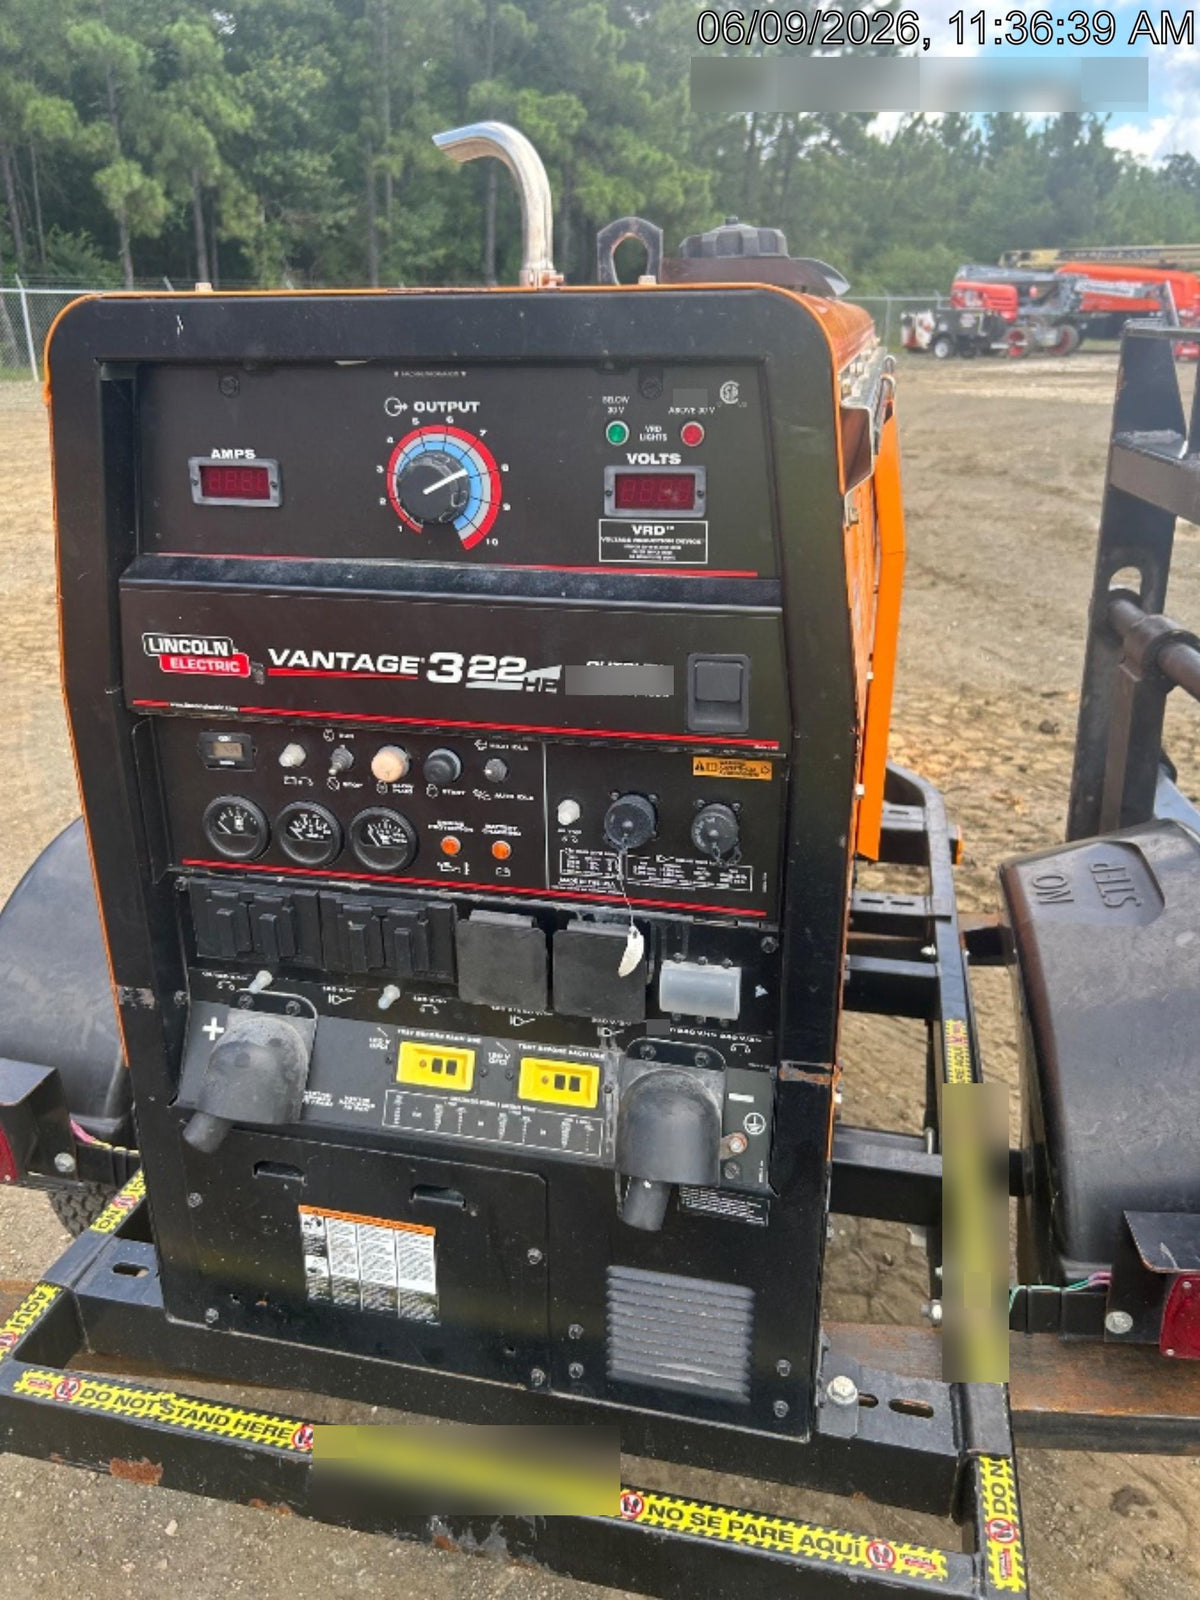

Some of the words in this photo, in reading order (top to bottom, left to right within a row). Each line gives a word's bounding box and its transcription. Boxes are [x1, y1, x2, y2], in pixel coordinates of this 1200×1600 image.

[413, 400, 481, 413] OUTPUT
[412, 417, 420, 426] 5
[445, 415, 454, 424] 6
[479, 429, 488, 437] 7
[639, 433, 668, 443] LIGHTS
[211, 448, 257, 460] AMPS
[626, 452, 682, 465] VOLTS
[376, 465, 384, 474] 3
[379, 497, 387, 506] 2
[486, 537, 499, 546] 10
[148, 637, 229, 657] LINCOLN
[169, 658, 241, 673] ELECTRIC
[267, 648, 421, 675] VANTAGE
[426, 652, 527, 684] 322
[1031, 874, 1075, 905] NO
[1090, 863, 1142, 908] STEP
[80, 1388, 112, 1401] DO
[113, 1394, 161, 1411] NOT
[160, 1397, 230, 1427] STAND
[233, 1417, 294, 1440] HERE
[990, 1482, 1009, 1514] DO
[647, 1503, 684, 1522] NO
[690, 1511, 723, 1530] SE
[728, 1519, 794, 1544] PARE
